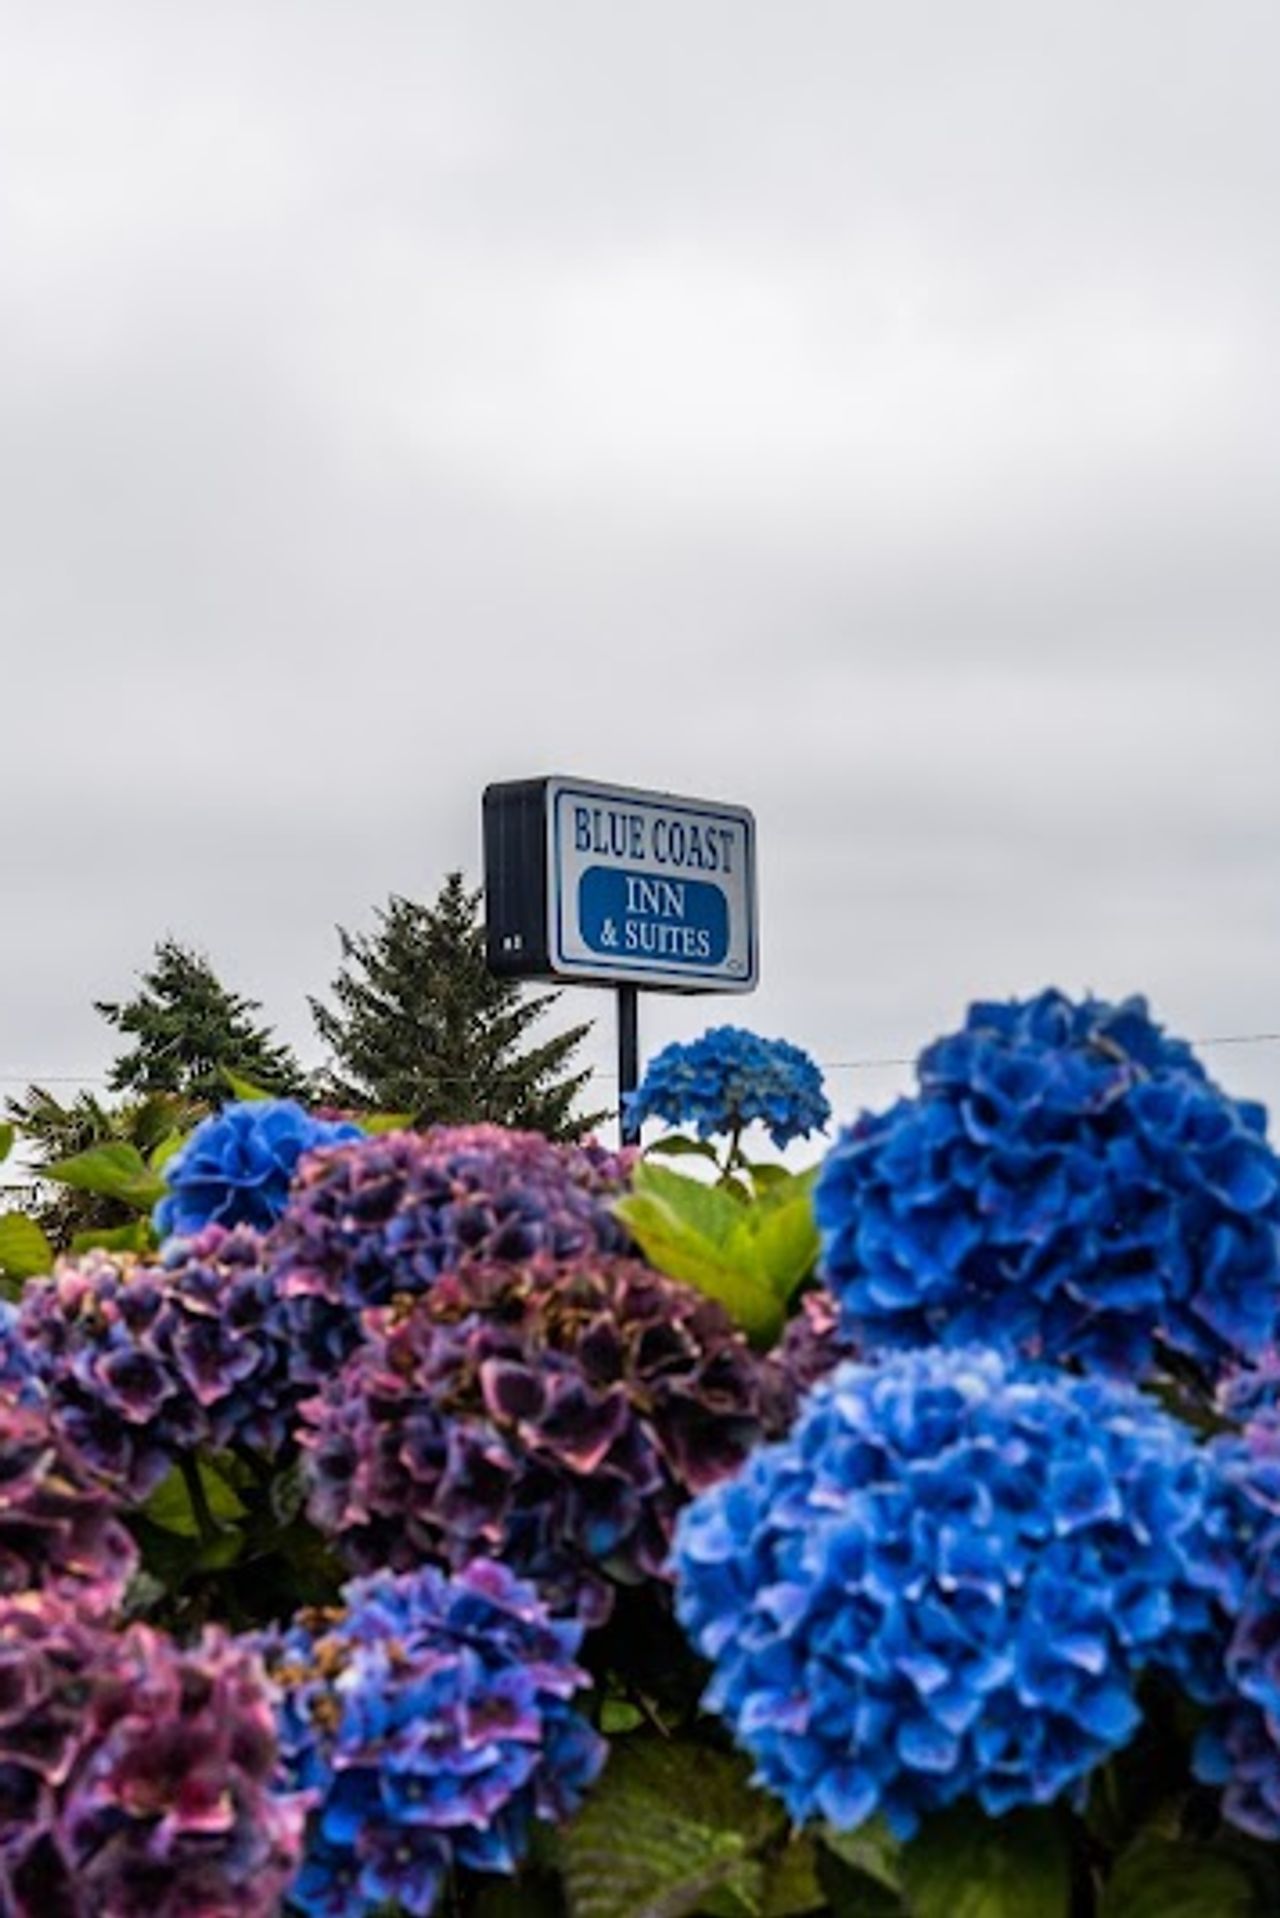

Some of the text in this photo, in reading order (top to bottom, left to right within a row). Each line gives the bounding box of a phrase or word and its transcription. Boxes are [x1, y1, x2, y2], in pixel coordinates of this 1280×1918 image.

[575, 807, 735, 874] BLUE COAST
[625, 876, 685, 918] INN
[600, 918, 710, 957] & SUITES
